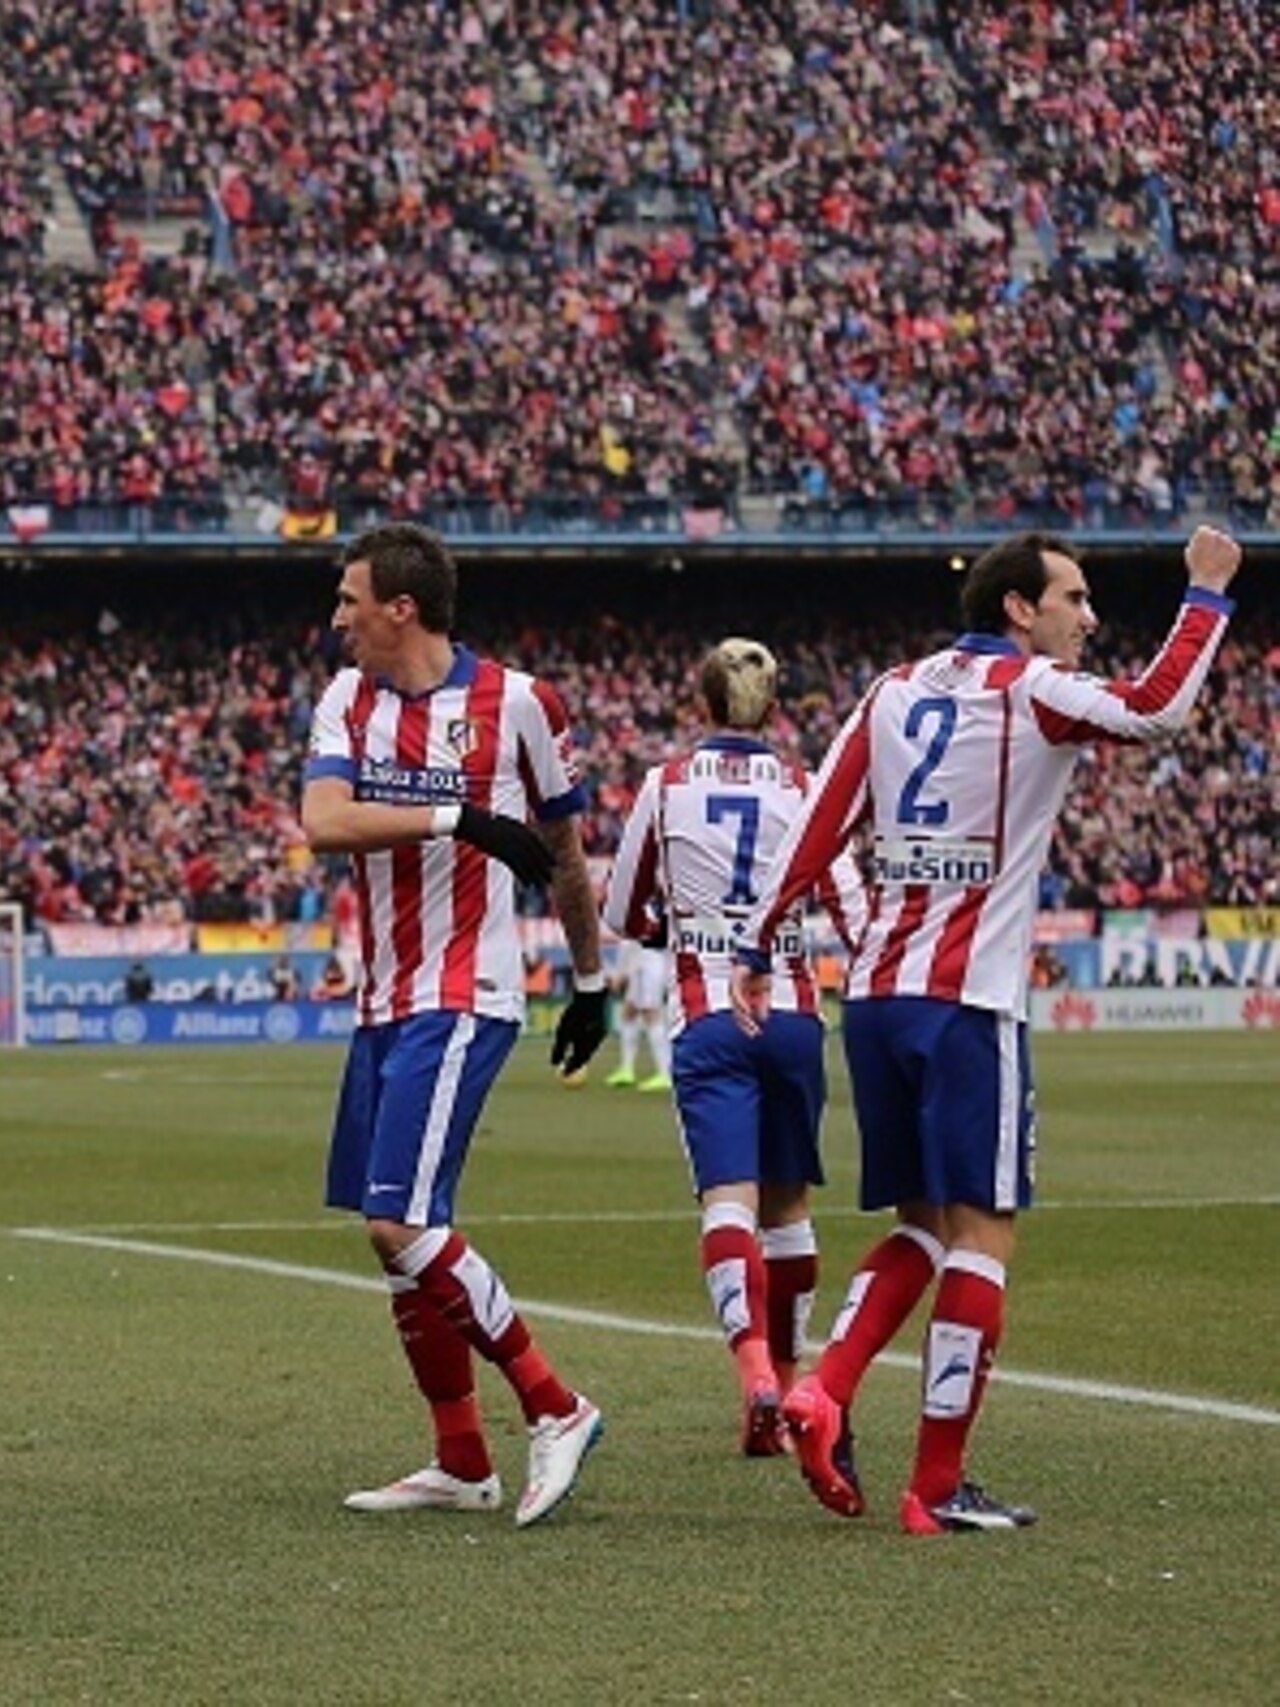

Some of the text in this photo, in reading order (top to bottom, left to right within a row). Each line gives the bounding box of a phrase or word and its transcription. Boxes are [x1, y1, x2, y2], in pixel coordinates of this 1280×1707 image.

[896, 697, 958, 826] 2
[706, 796, 759, 905] 7
[172, 1010, 261, 1036] Allianz
